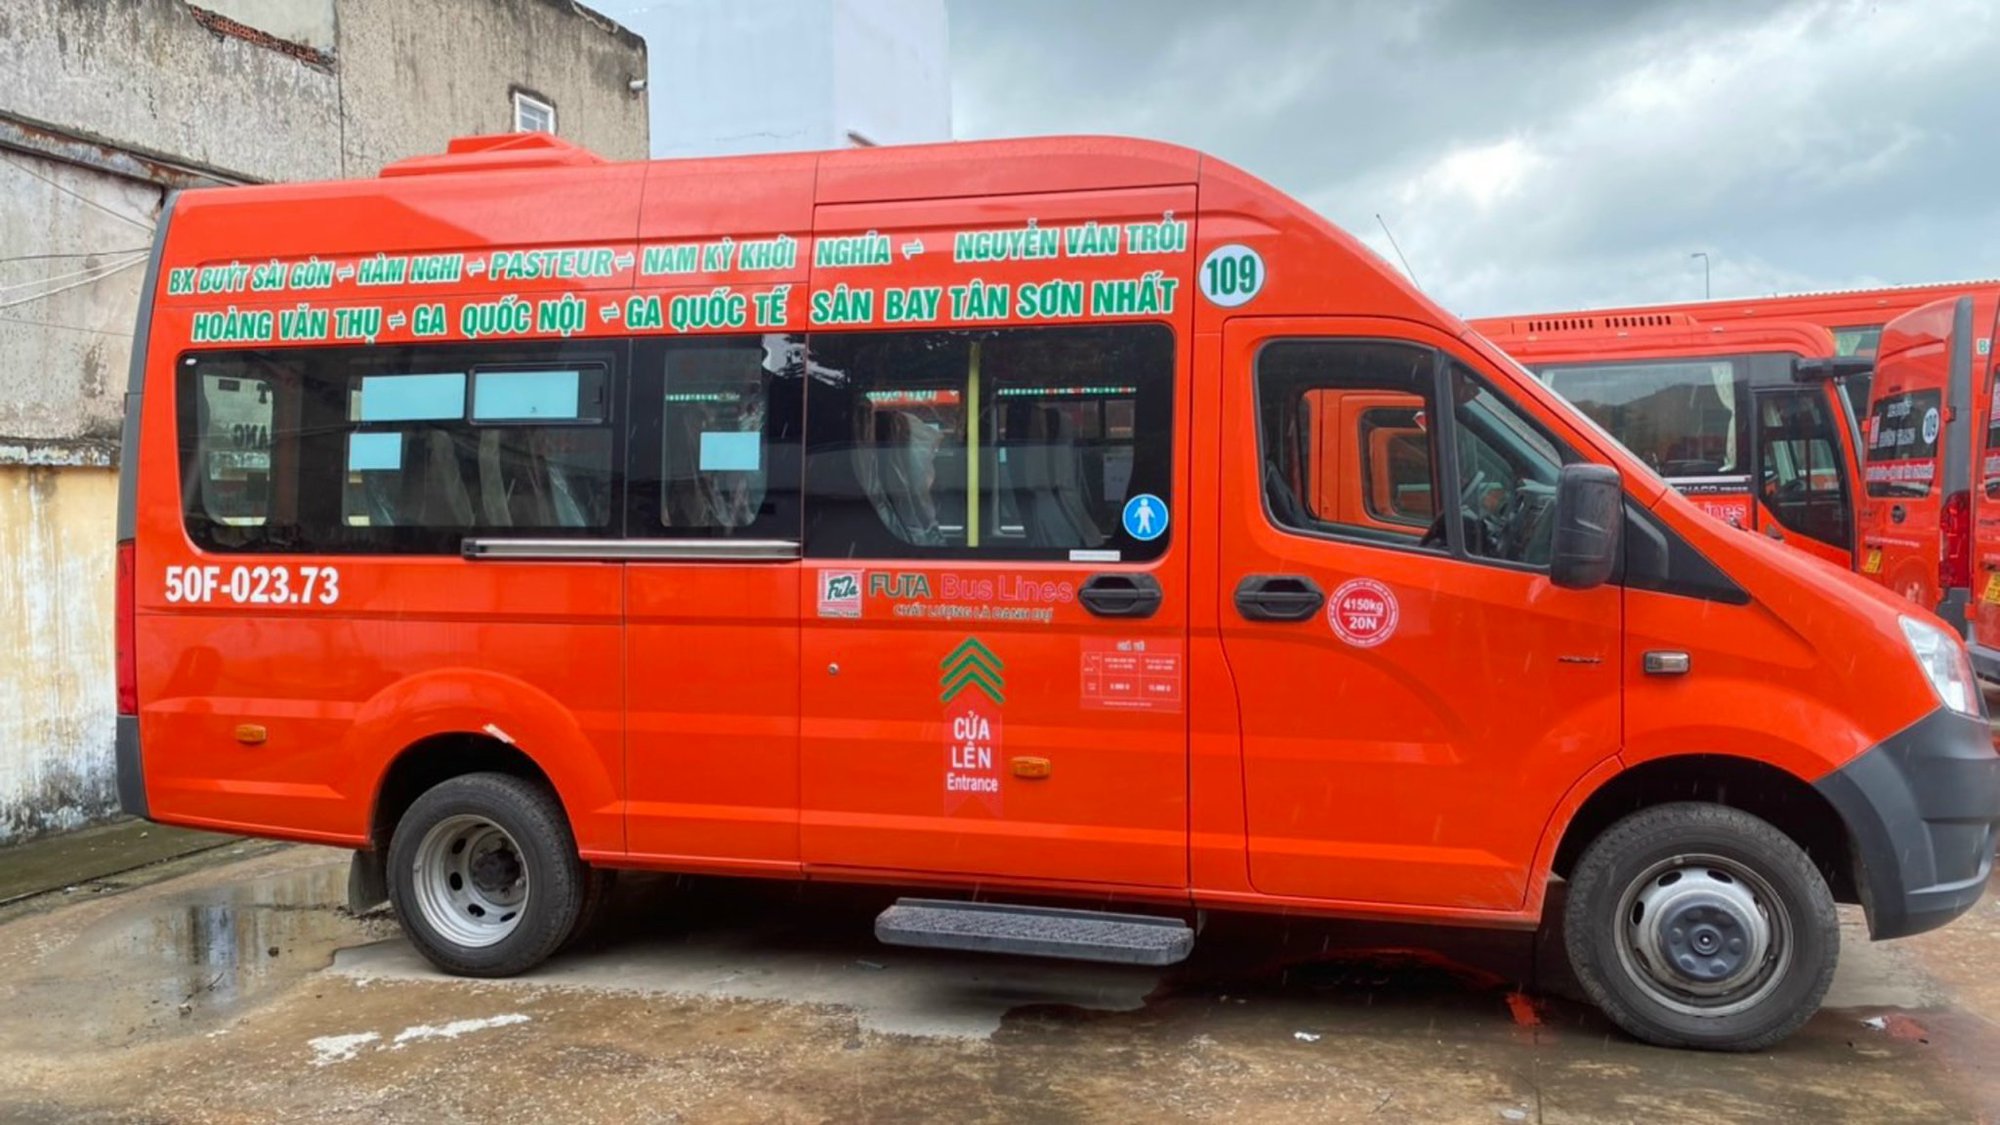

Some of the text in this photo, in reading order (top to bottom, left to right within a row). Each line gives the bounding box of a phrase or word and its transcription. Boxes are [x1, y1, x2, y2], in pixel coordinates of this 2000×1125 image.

[168, 211, 1188, 294] BX BUÝT SÀI GÒN HÀM NGHI PASTEUR NAM KỲ KHỞI NGHĨA NGUYỄN VĂN TRỖI
[1206, 254, 1257, 296] 109
[191, 271, 1178, 344] HOÀNG VĂN THỤ GA QUỐC NỘI GA QUỐC TẾ SÂN BAY TÂN SƠN NHẤT
[165, 566, 339, 604] 50F-023.73
[870, 572, 1073, 602] FUTA Bus Lines
[1343, 598, 1384, 615] 4150kg
[1349, 616, 1377, 630] 20N
[954, 710, 990, 740] CỬA
[952, 741, 991, 769] LÊN
[947, 772, 998, 792] Entrance
